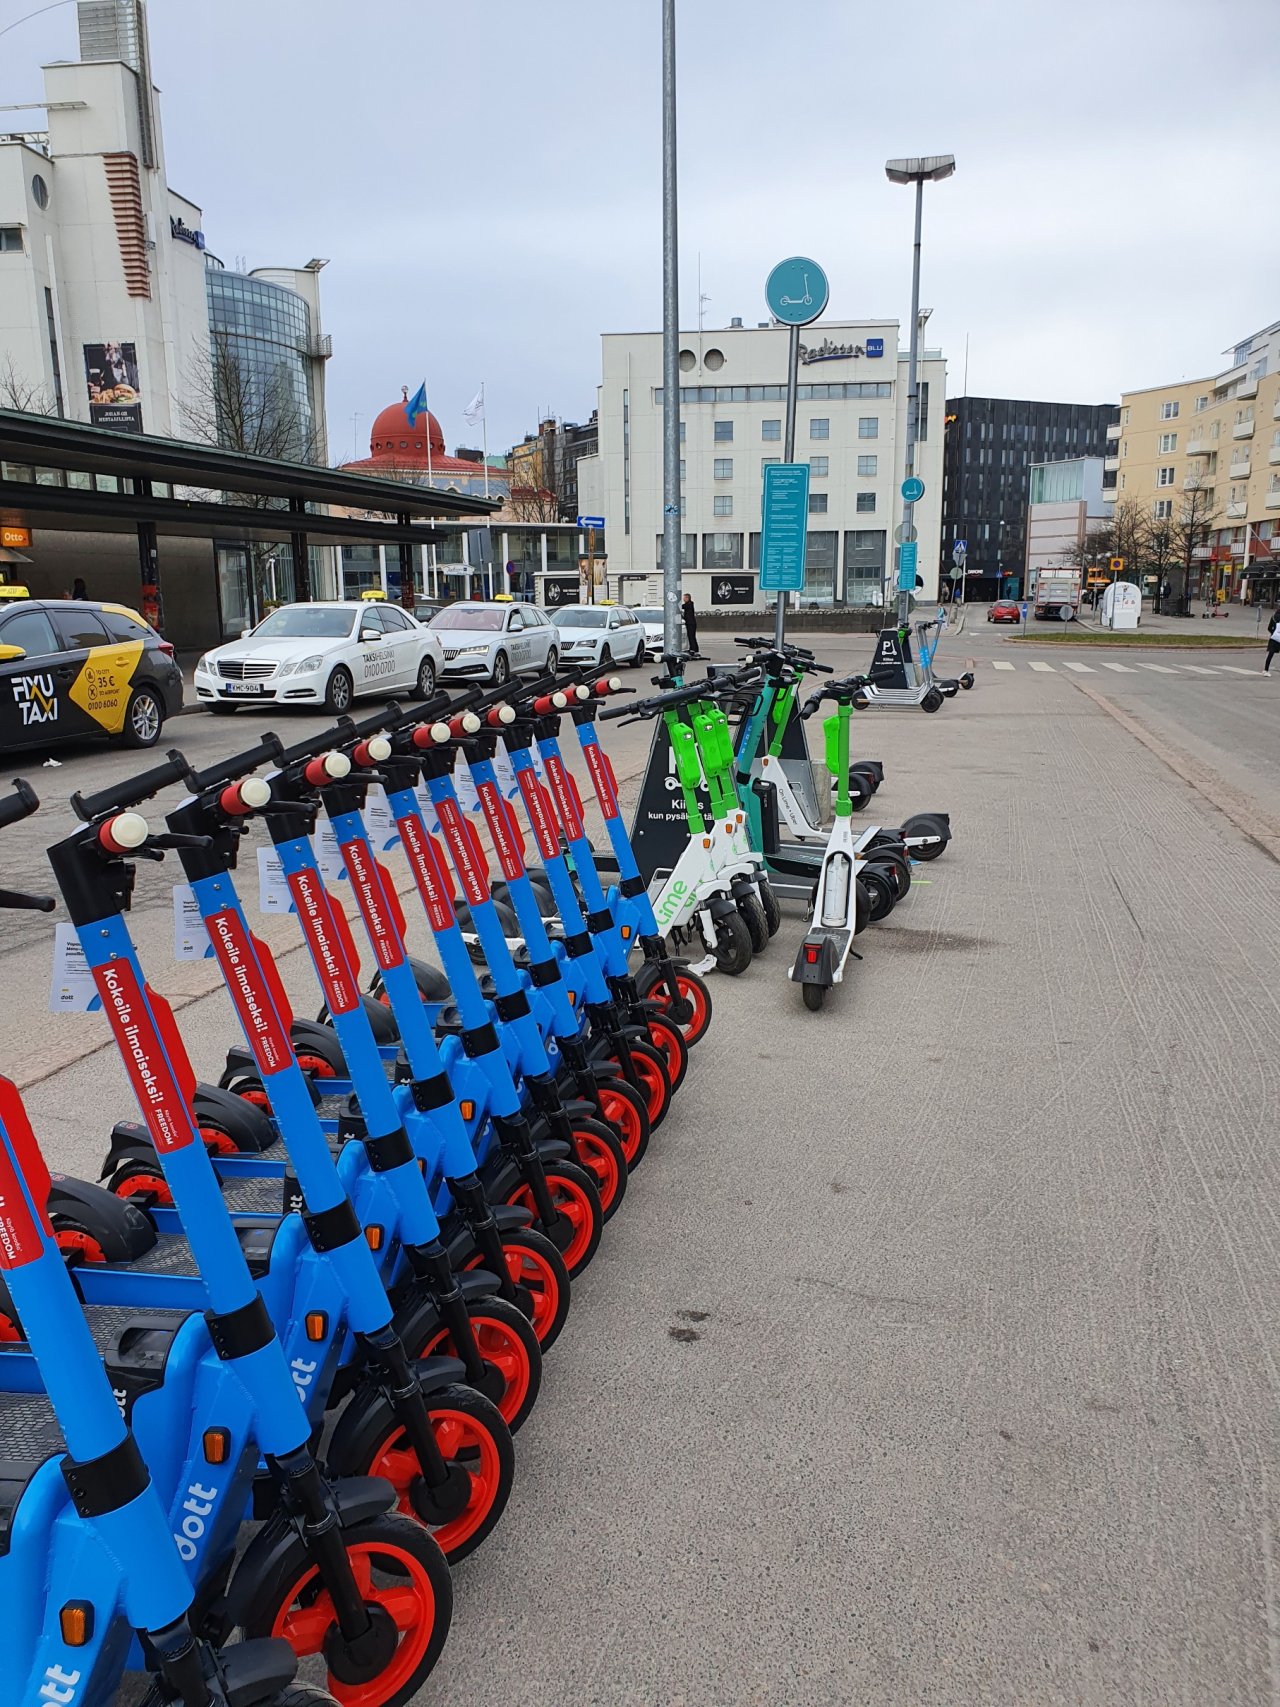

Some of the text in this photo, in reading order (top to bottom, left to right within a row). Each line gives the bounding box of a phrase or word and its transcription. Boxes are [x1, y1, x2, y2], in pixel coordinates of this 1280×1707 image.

[798, 337, 865, 365] Radisson
[883, 641, 891, 650] P
[97, 675, 115, 688] 35 €
[18, 698, 58, 726] TAXI
[88, 701, 103, 711] 0100
[482, 786, 495, 815] Kokeile
[648, 811, 664, 820] kun
[703, 812, 717, 820] tä
[671, 799, 705, 810] Kiis
[403, 819, 439, 902] Kokeile ilmaiseksi!
[450, 826, 483, 901] Kokeile ilmaiseksi!
[348, 844, 386, 936] Kokeile ilmaiseksi!
[297, 875, 340, 977] Kokeile ilmaiseksi!
[215, 917, 269, 1033] Kokeile ilmaiseksi!
[332, 980, 346, 1008] FREEDOM
[102, 968, 164, 1104] Kokeile ilmaiseksi!
[260, 1036, 276, 1068] FREEDOM
[155, 1108, 173, 1146] FREEDOM
[173, 1482, 218, 1561] dott
